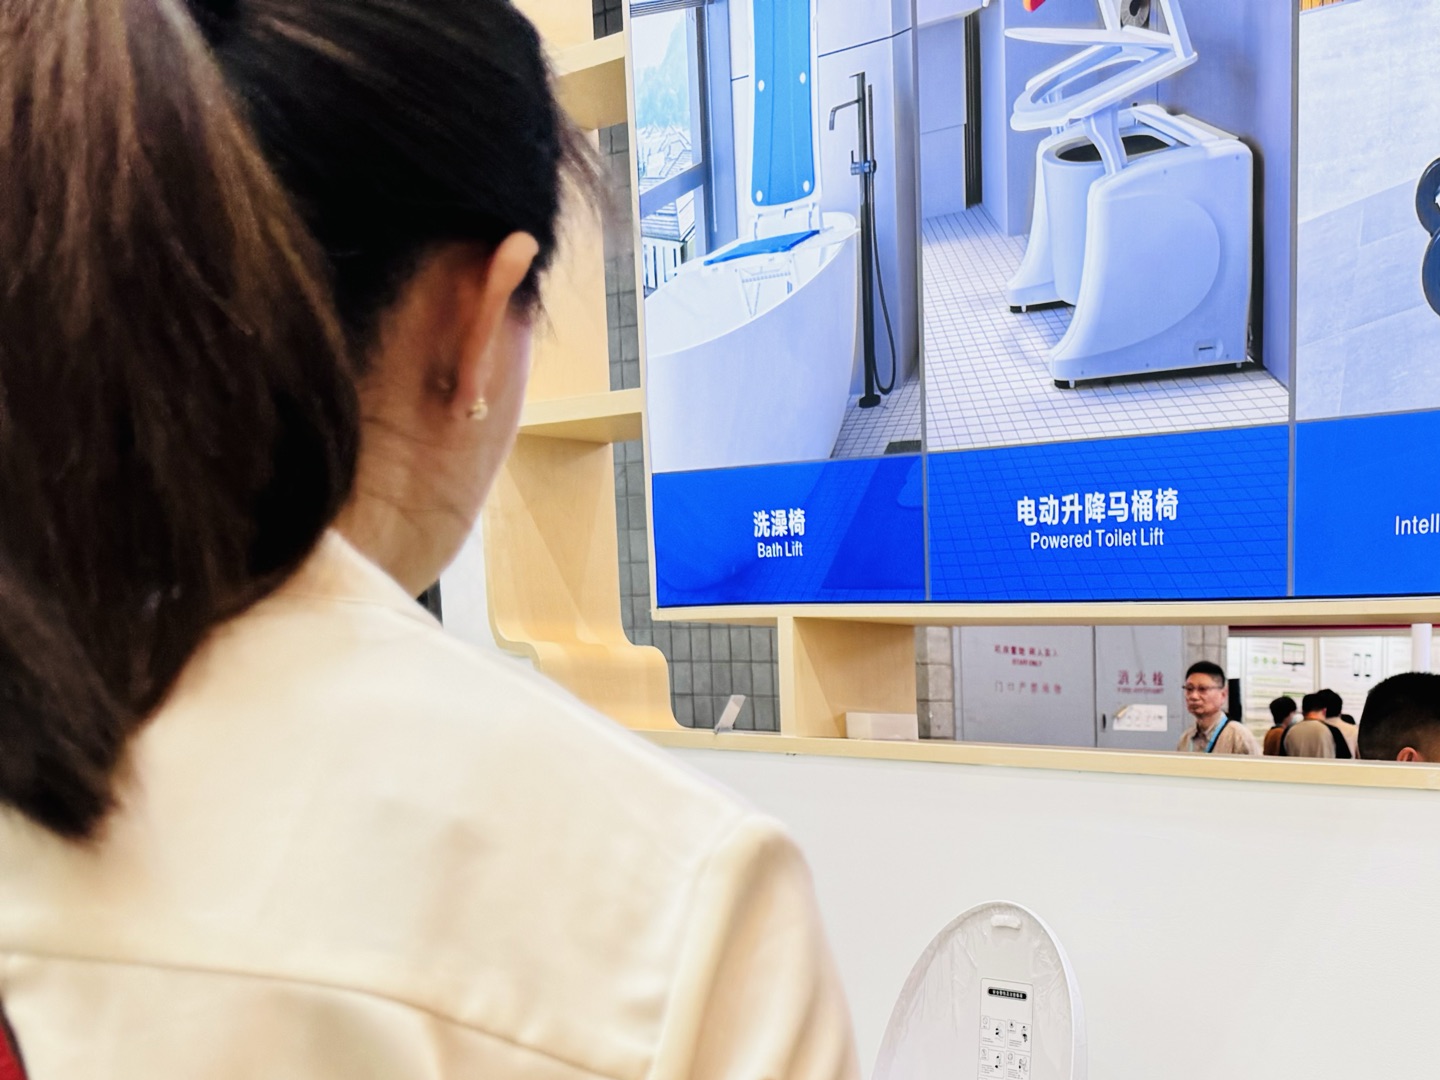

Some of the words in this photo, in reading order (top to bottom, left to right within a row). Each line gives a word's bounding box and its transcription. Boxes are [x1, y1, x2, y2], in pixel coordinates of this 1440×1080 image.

[1016, 487, 1179, 527] 电动升降马桶椅
[753, 507, 806, 538] 洗澡椅
[757, 541, 783, 558] Bath
[784, 540, 804, 557] Lift
[1030, 529, 1092, 550] Powered
[1095, 528, 1137, 547] Toilet
[1140, 526, 1164, 546] Lift
